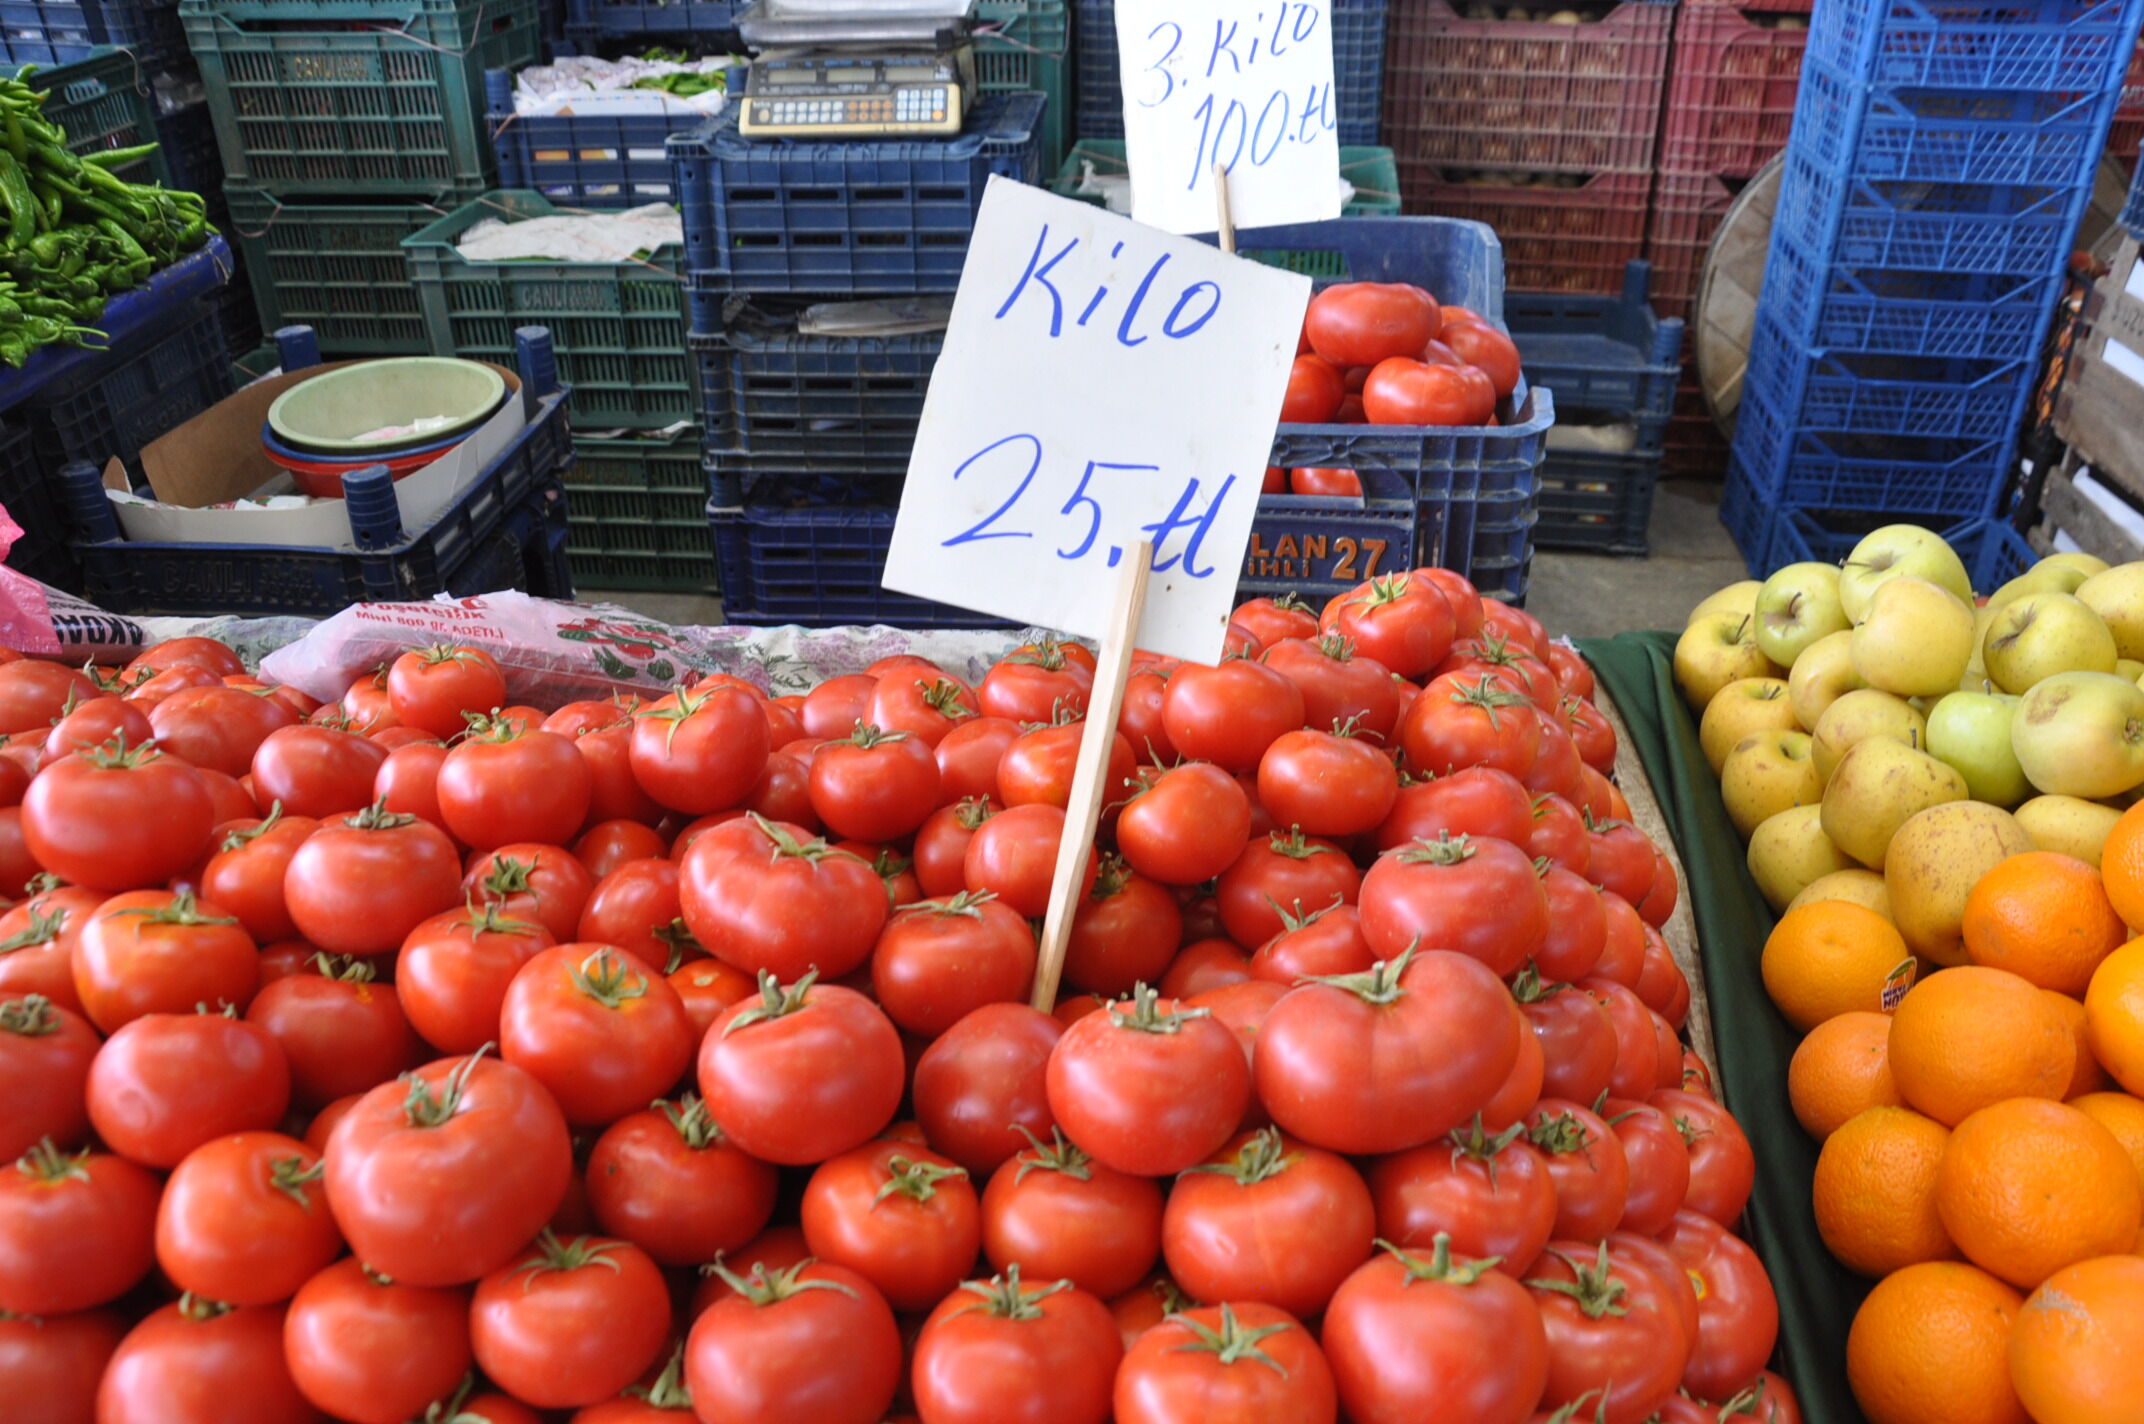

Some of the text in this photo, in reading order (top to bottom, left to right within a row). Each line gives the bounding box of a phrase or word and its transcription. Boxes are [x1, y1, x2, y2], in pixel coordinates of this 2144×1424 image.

[1206, 1, 1319, 77] Kilo
[995, 223, 1222, 347] Kilo
[1251, 533, 1327, 559] LAN
[1330, 536, 1387, 580] 27
